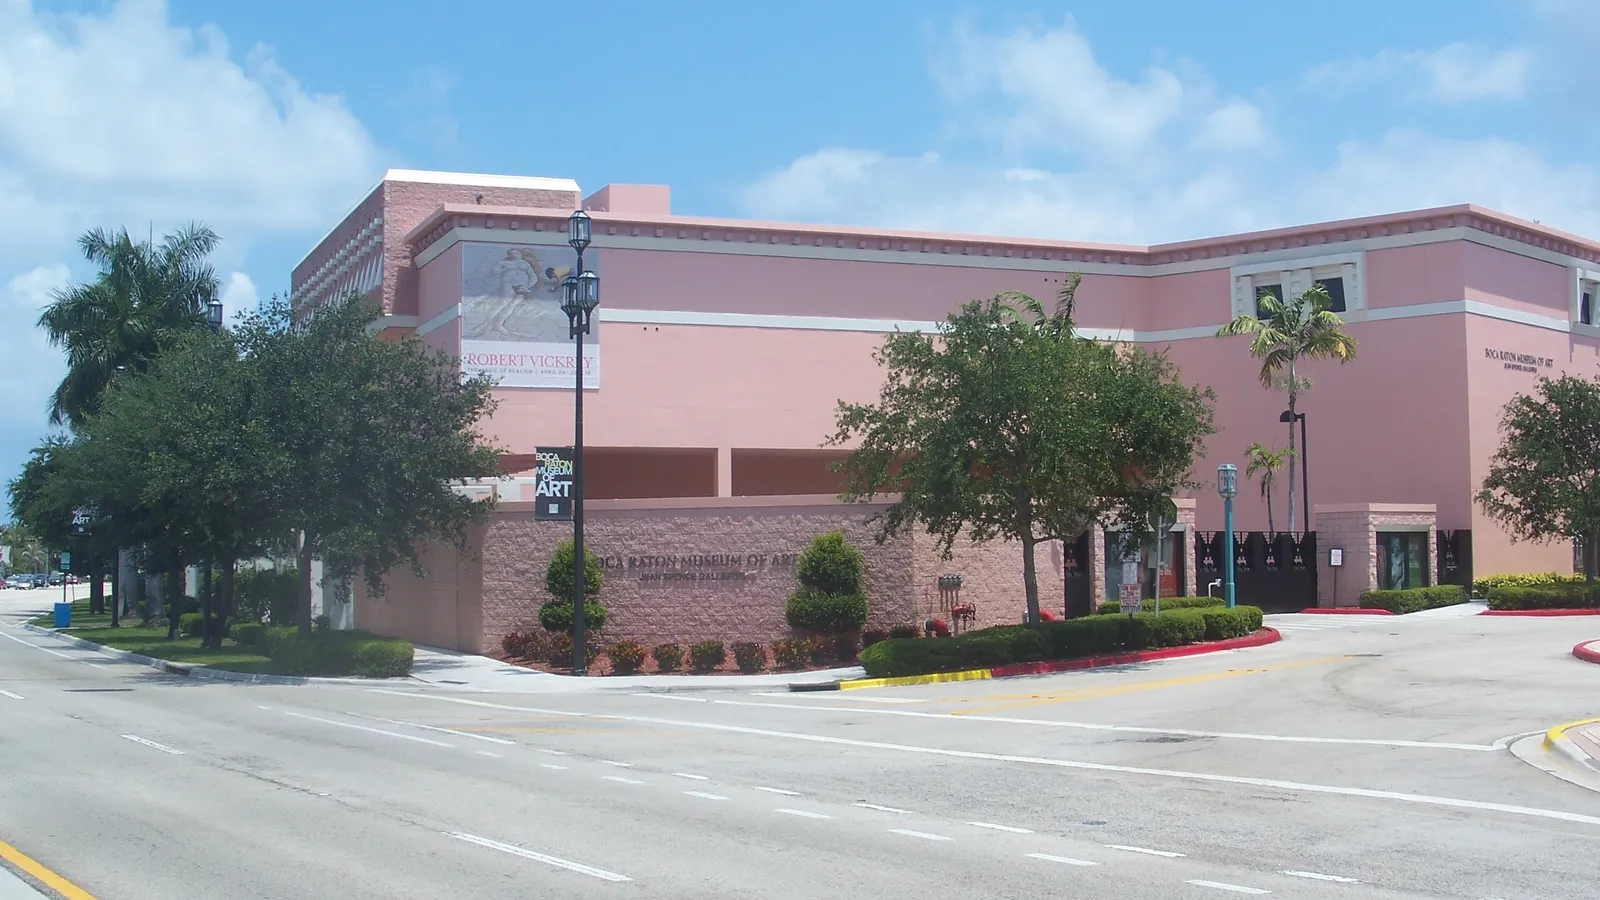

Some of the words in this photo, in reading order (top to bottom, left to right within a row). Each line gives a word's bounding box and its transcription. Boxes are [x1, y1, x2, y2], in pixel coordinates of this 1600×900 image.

[468, 352, 527, 366] ROBERT
[529, 355, 594, 368] VICKRY
[536, 452, 559, 461] BOCA
[545, 460, 573, 468] RATON
[535, 466, 573, 476] MUSEUM
[542, 474, 555, 482] OF
[535, 480, 573, 497] ART
[72, 516, 90, 525] ART
[596, 556, 623, 568] OCA
[629, 555, 677, 568] RATON
[680, 554, 742, 567] MUSEUM
[747, 553, 768, 566] OF
